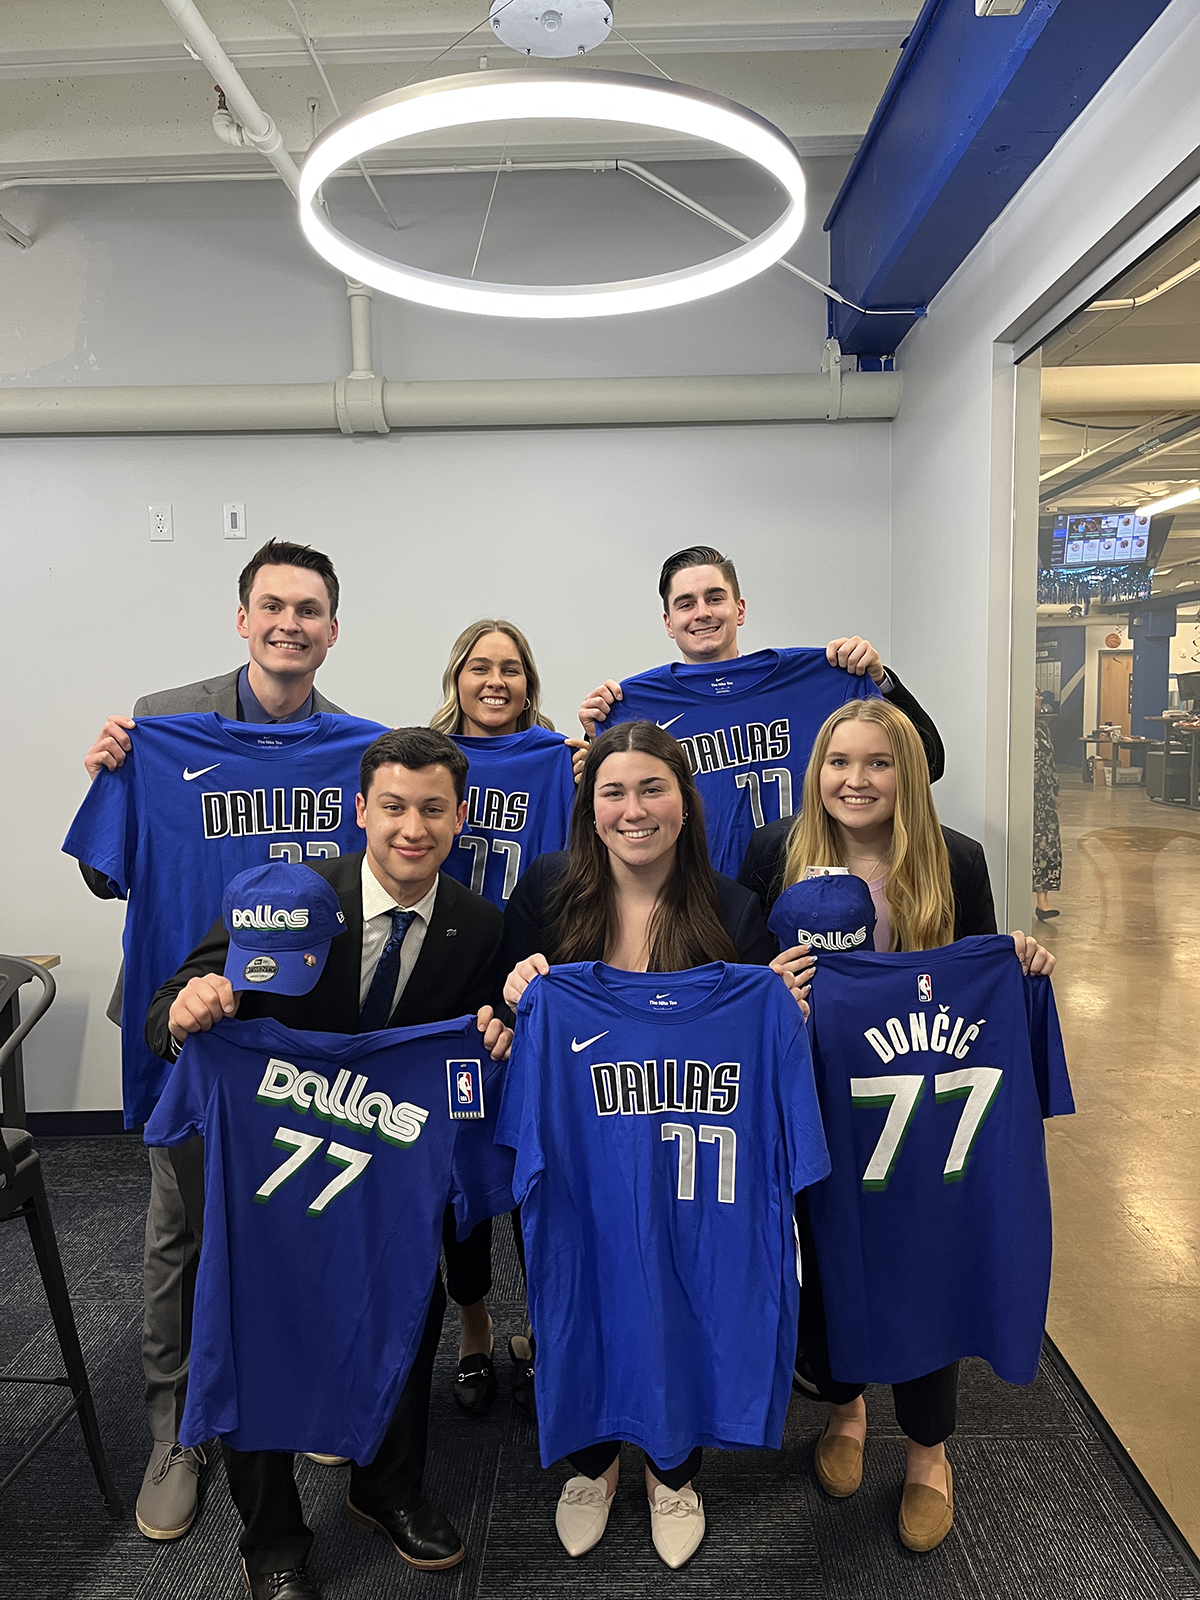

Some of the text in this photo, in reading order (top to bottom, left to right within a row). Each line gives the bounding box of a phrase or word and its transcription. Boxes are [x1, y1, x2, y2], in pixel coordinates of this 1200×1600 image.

[676, 718, 790, 777] DALLAS
[201, 787, 342, 839] DALLAS
[467, 786, 530, 832] LAS
[735, 768, 793, 829] 77
[458, 835, 522, 900] 77
[232, 905, 309, 931] Dallas
[797, 925, 867, 951] Dallas
[863, 1003, 987, 1064] DONČIĆ
[256, 1058, 430, 1145] Dallas
[590, 1059, 741, 1116] DALLAS
[850, 1066, 1004, 1187] 77
[254, 1126, 373, 1215] 77
[661, 1122, 737, 1204] 77
